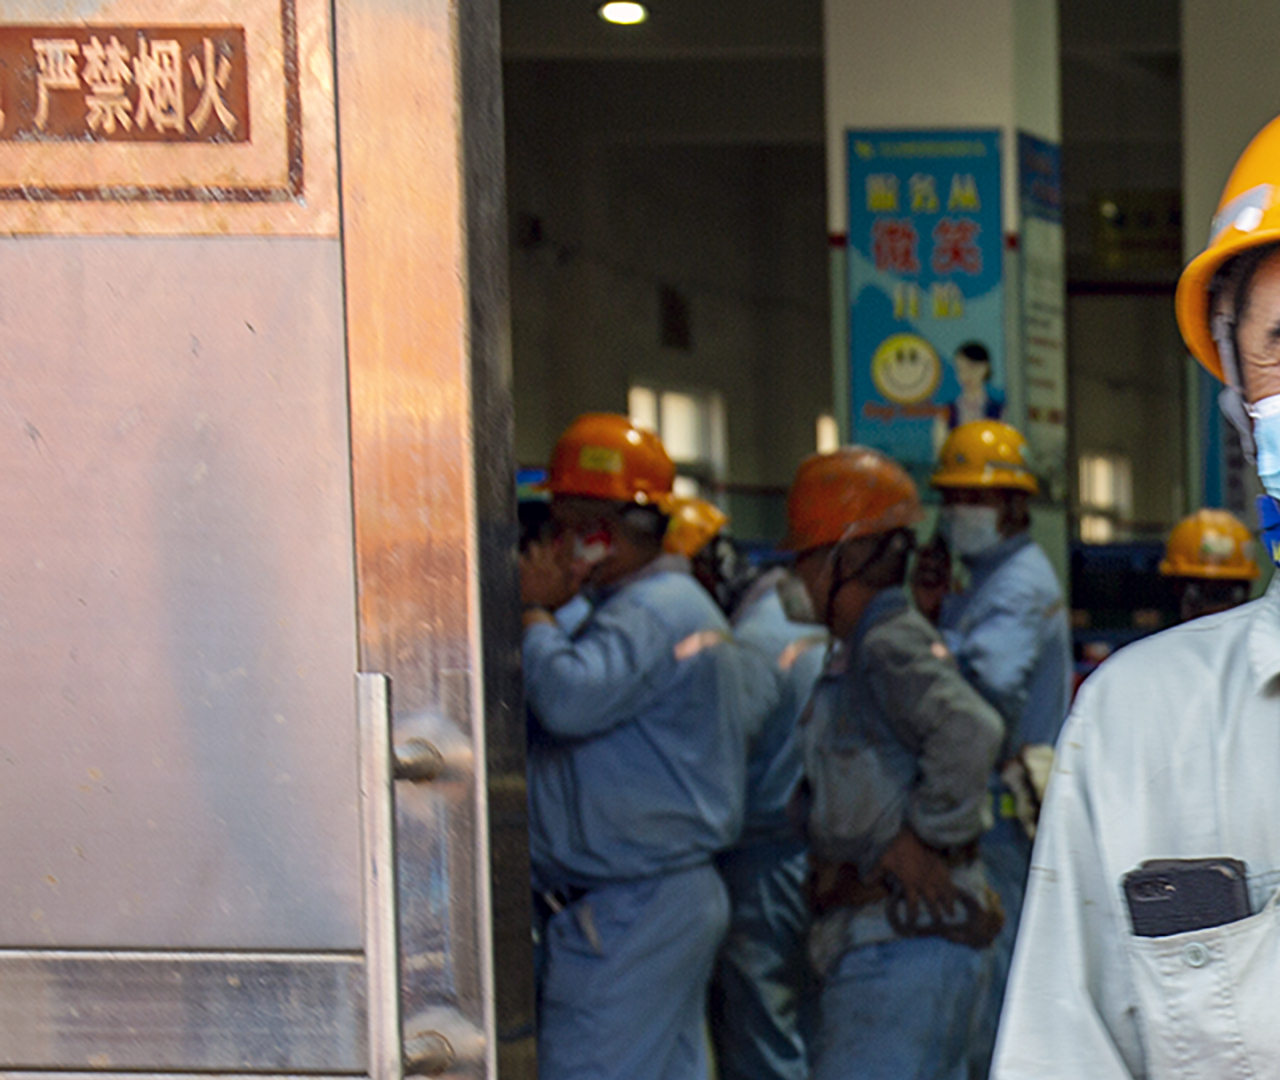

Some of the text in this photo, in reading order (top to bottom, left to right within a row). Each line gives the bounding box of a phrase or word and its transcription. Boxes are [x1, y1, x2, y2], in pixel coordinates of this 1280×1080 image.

[31, 31, 238, 134] 严禁烟火
[871, 216, 983, 275] 微笑
